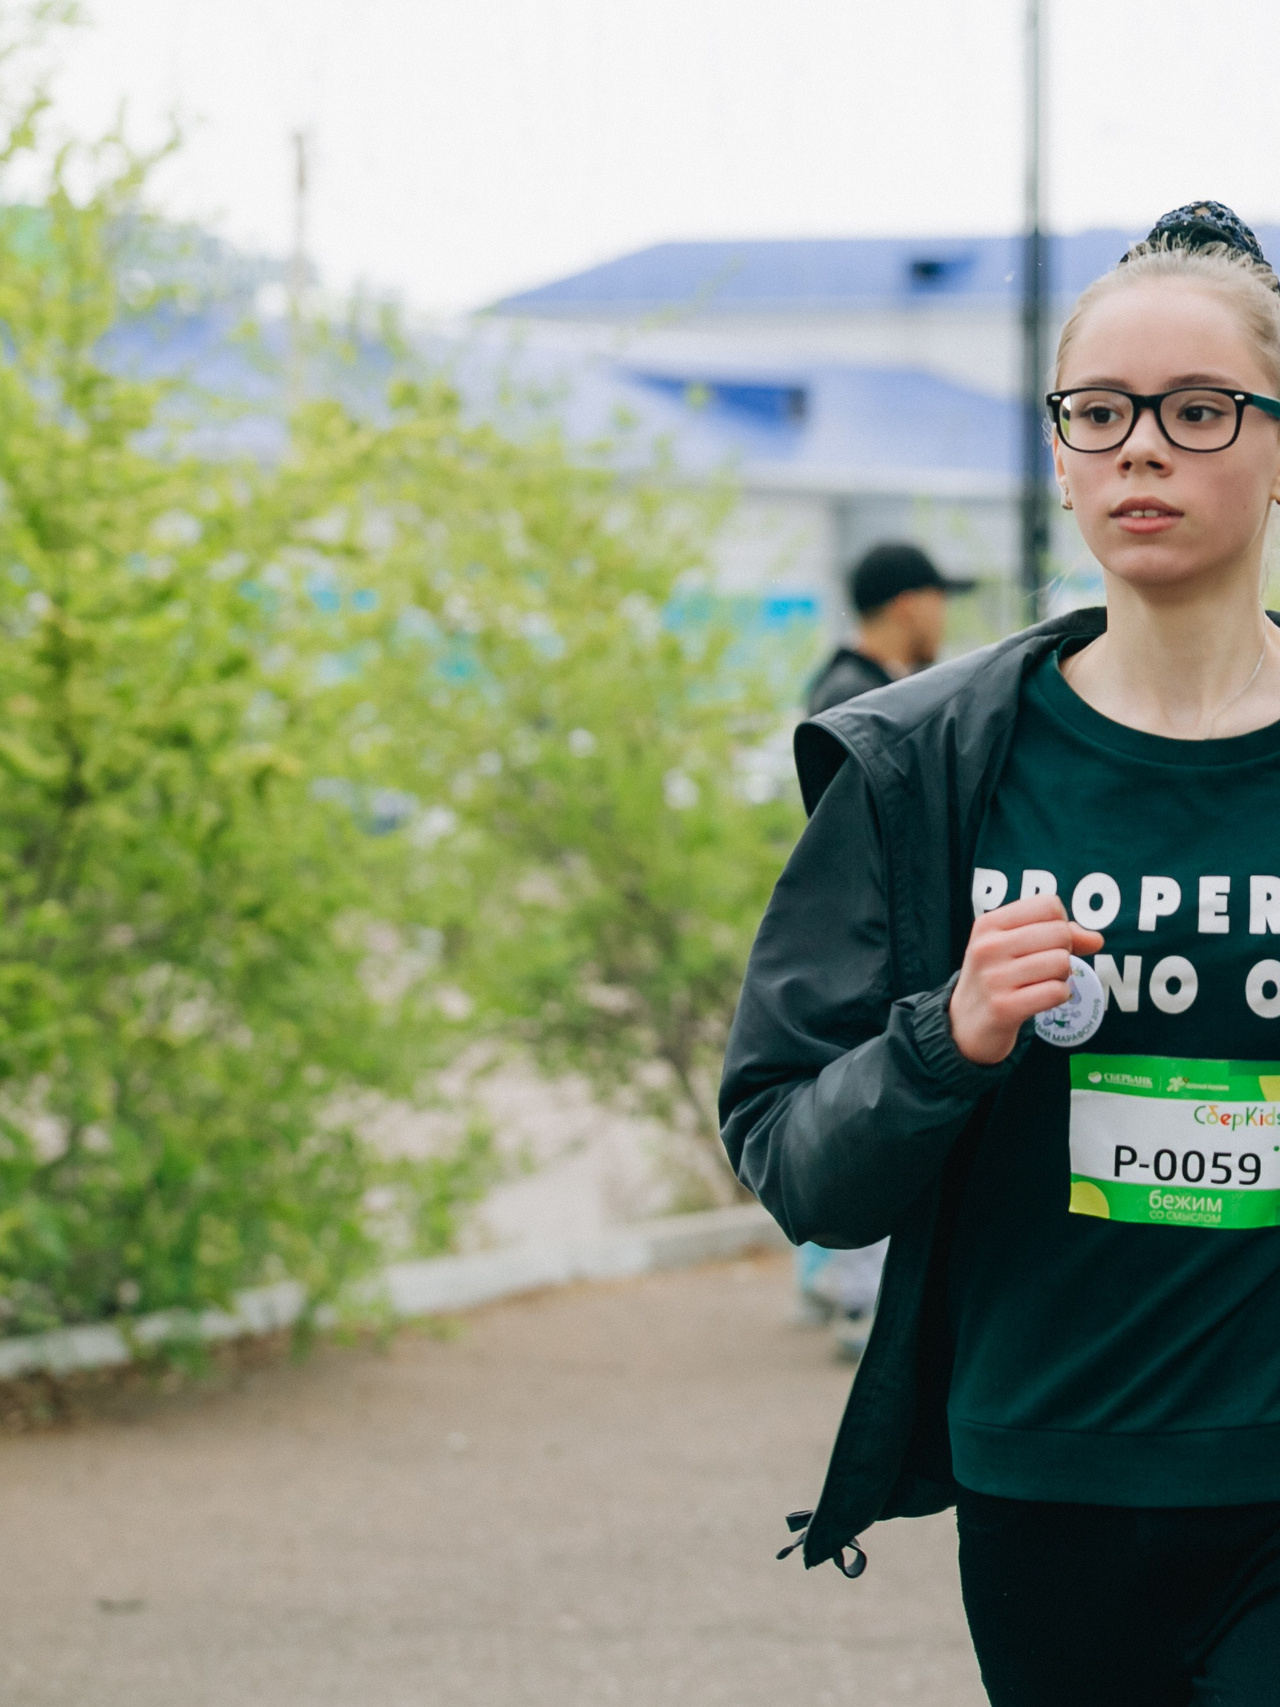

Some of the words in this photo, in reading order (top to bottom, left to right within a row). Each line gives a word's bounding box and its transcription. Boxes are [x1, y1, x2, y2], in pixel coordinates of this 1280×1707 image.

[1094, 954, 1198, 1014] NO
[1052, 1020, 1095, 1042] МАРАФОН
[1104, 1073, 1152, 1085] СБЕРБАНК
[1149, 1189, 1223, 1213] бежим
